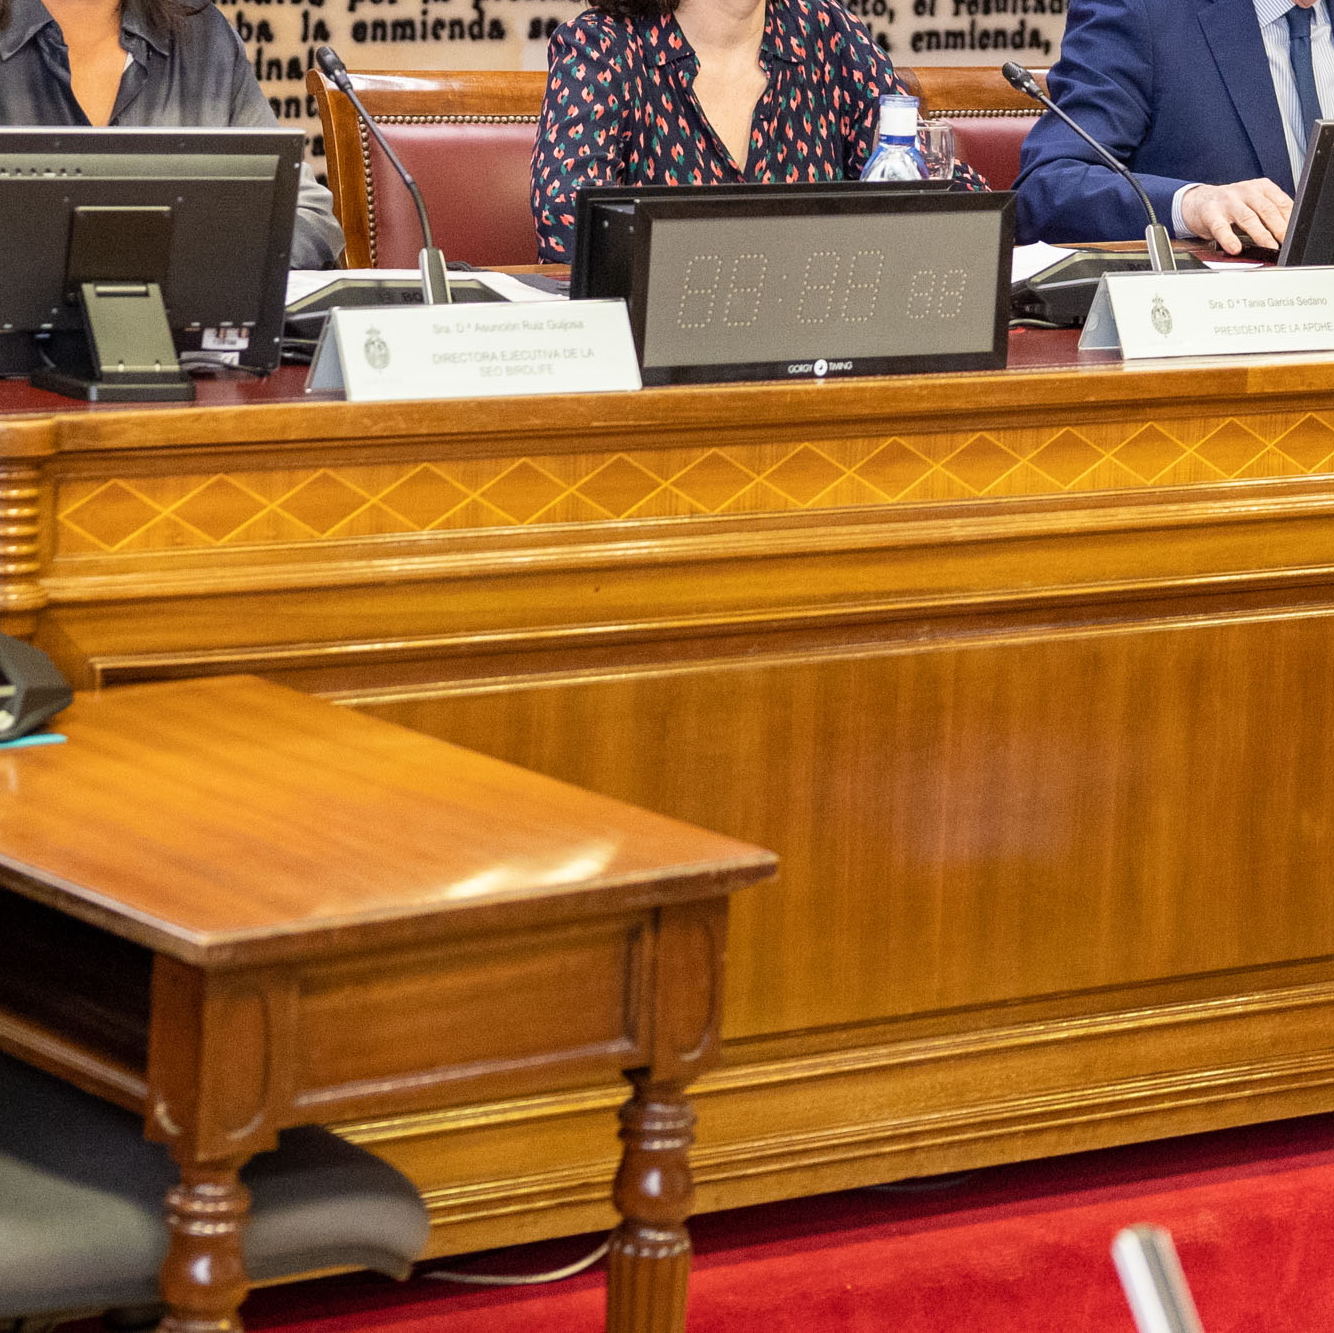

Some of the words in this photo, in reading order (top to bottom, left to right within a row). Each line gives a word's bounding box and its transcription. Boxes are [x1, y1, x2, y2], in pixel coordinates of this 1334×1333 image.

[1242, 298, 1265, 307] Tania
[1213, 323, 1272, 335] PRESIDENTA
[1274, 323, 1287, 333] DE
[1289, 322, 1301, 332] LA
[432, 351, 498, 364] DIRECTORA
[500, 348, 559, 362] EJECUTIVA
[563, 348, 578, 359] DE
[580, 347, 594, 358] LA
